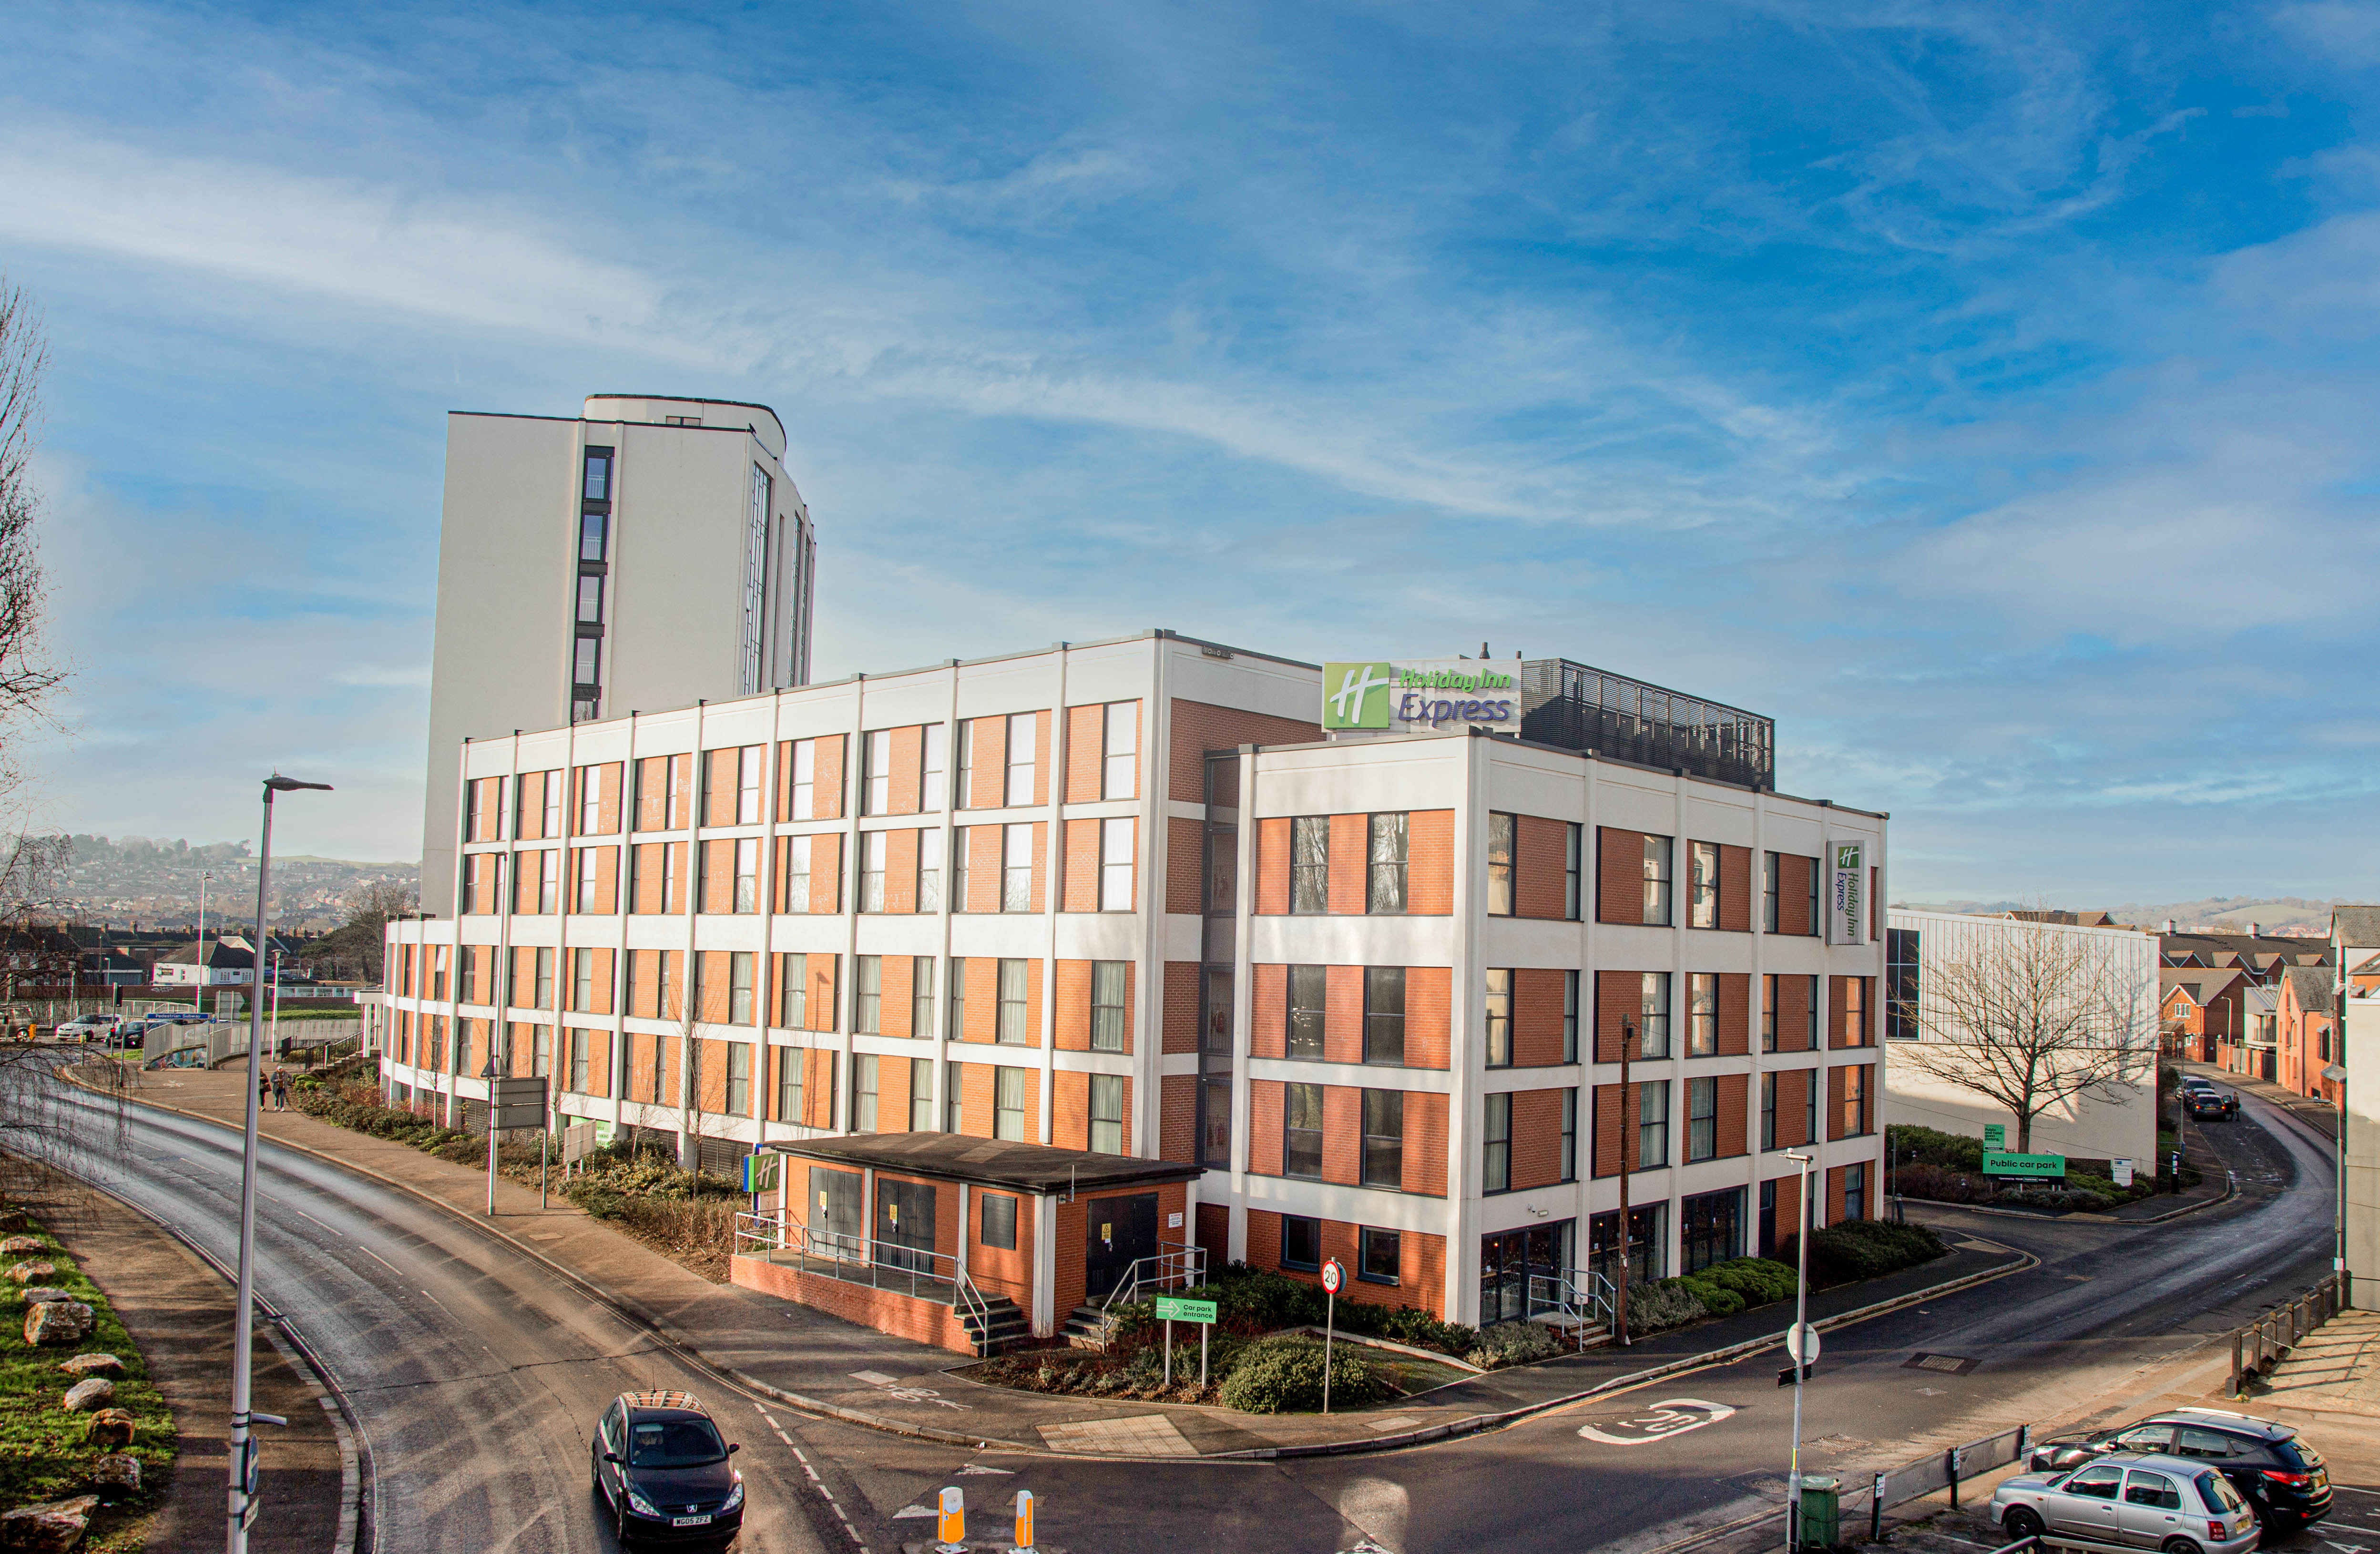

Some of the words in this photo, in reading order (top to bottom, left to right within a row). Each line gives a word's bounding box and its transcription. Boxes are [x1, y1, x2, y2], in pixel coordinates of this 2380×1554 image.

[1399, 667, 1477, 693] Holiday
[1479, 667, 1511, 688] Inn
[1398, 693, 1511, 729] Express
[1835, 872, 1847, 911] Express
[1845, 872, 1859, 916] Holiday
[1847, 918, 1858, 937] Inn
[1990, 1159, 2018, 1167] Public
[1325, 1270, 1337, 1285] 20
[696, 1515, 709, 1524] ZFZ
